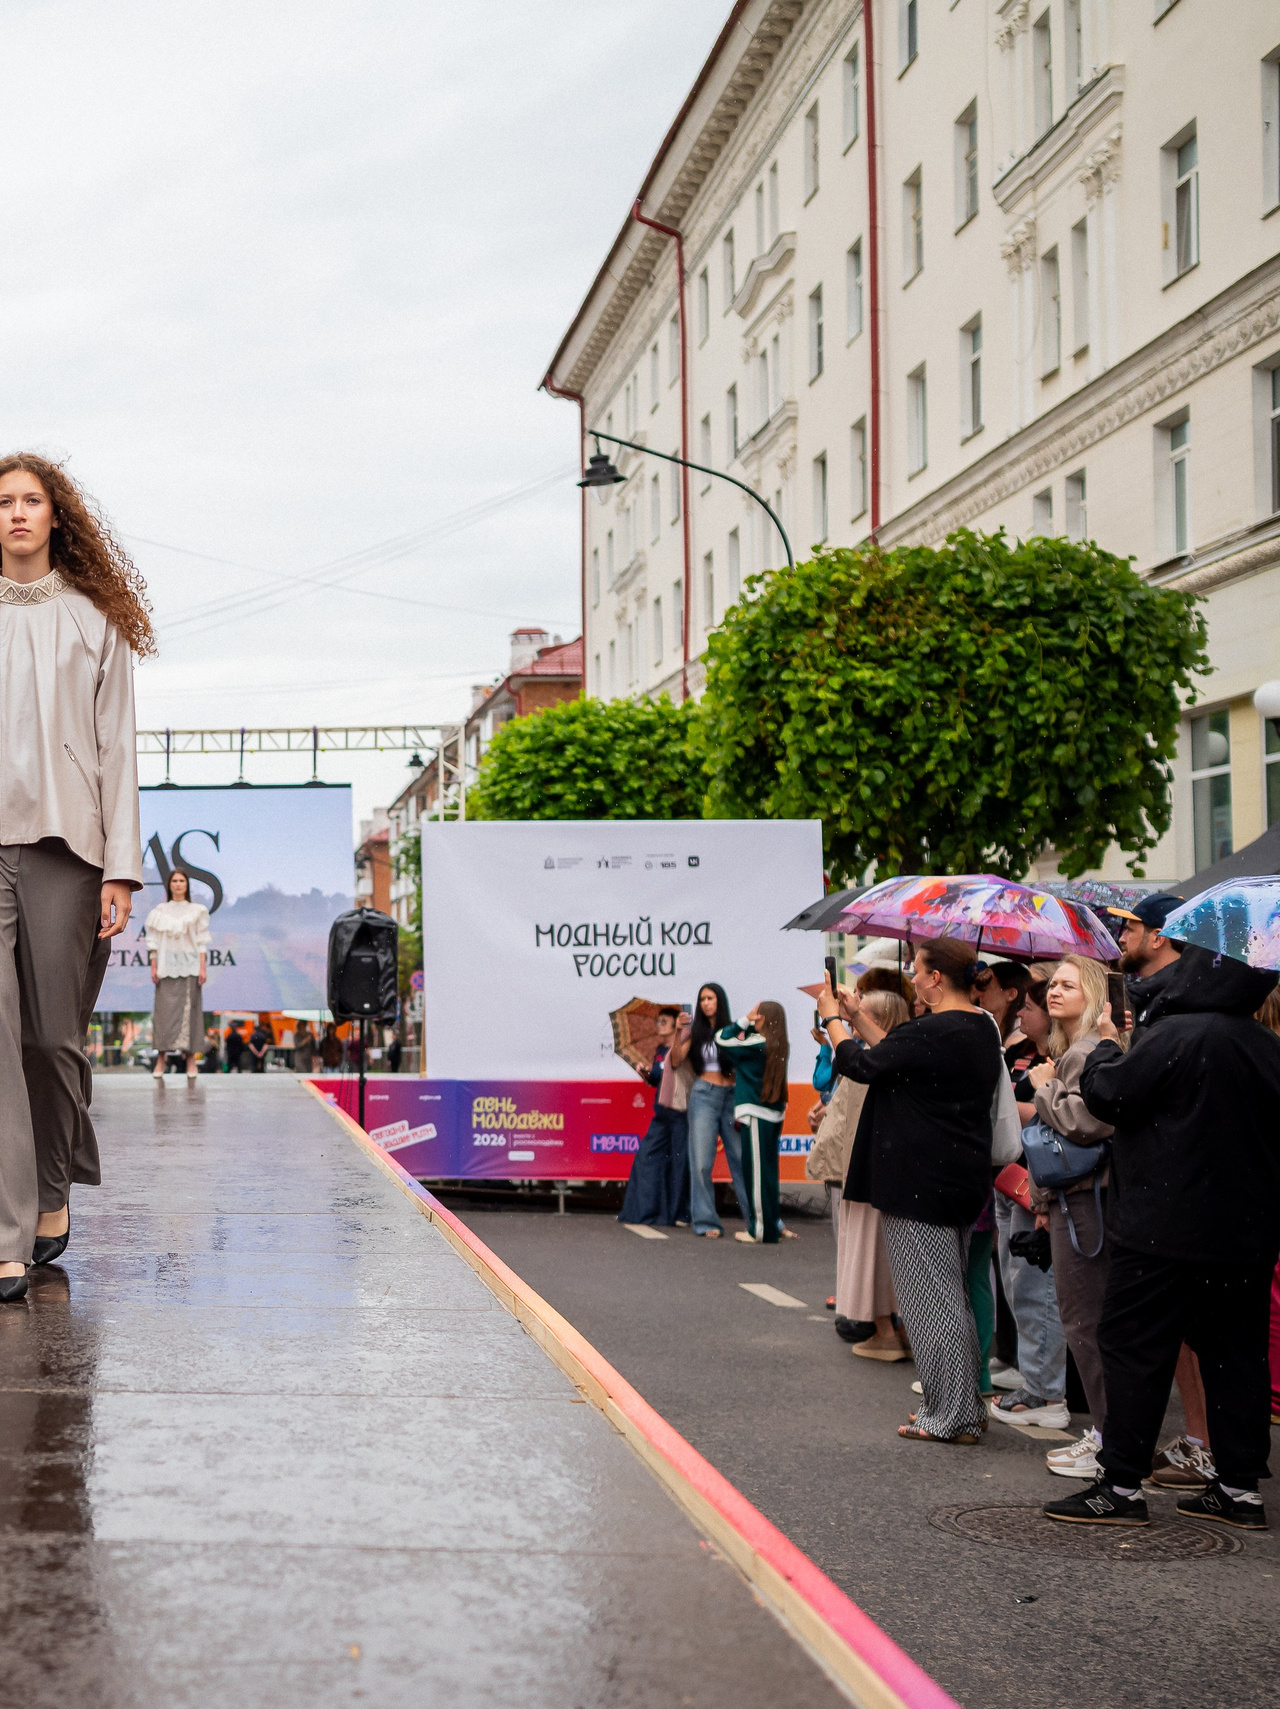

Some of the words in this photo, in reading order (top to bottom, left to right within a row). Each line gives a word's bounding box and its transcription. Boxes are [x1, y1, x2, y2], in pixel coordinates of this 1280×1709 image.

[535, 915, 653, 947] МОДНЫЙ
[661, 921, 713, 946] КОД
[573, 952, 676, 977] РОССИИ
[472, 1096, 517, 1113] ДЕНЬ
[472, 1109, 564, 1130] МОЛОДЁЖИ
[473, 1133, 507, 1147] 2026
[593, 1136, 639, 1151] МЕЧТА
